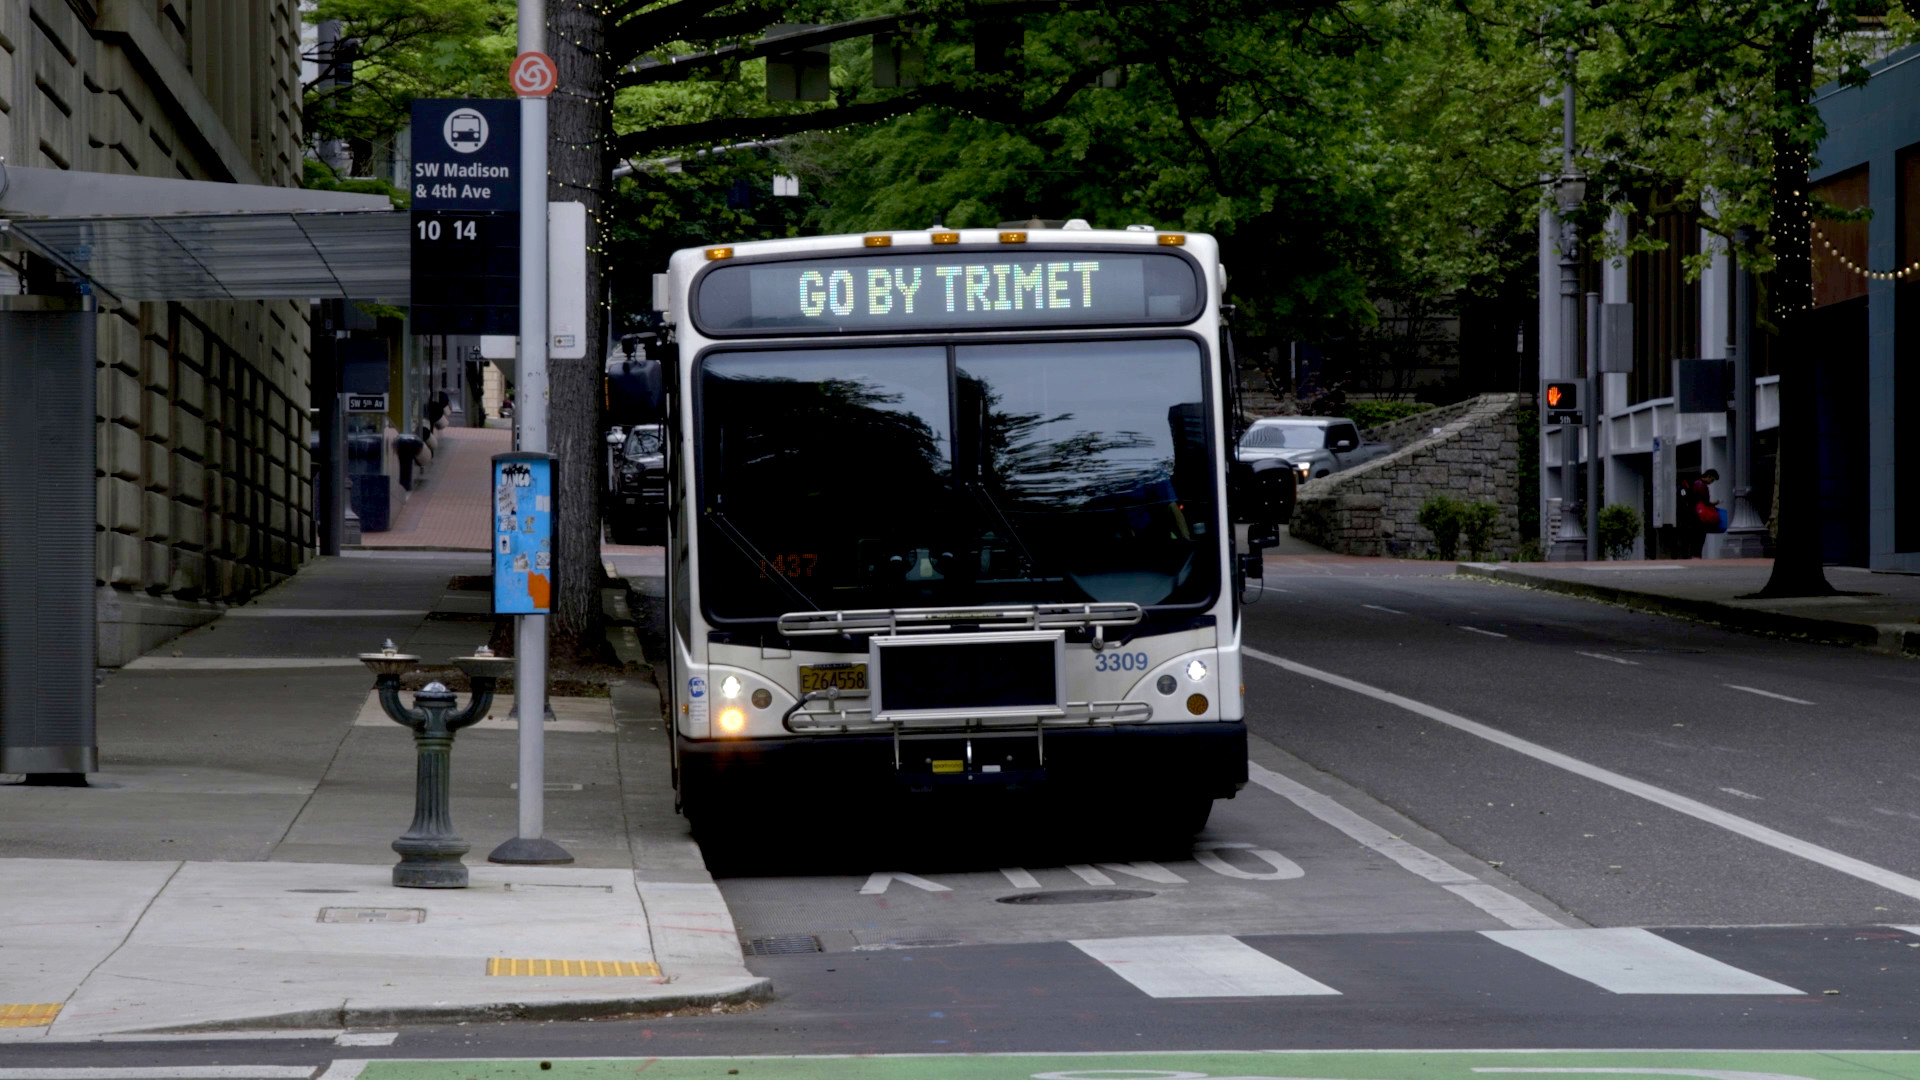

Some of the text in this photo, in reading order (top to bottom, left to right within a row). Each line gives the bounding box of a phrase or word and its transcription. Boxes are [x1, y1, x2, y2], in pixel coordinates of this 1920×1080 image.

[415, 162, 509, 178] SW Madison
[415, 183, 492, 199] & 4th Ave
[417, 220, 477, 240] 10 14
[799, 261, 1099, 317] GO BY TRIMET
[350, 399, 384, 408] SW 5th Av
[1559, 415, 1571, 424] 5th
[1095, 652, 1148, 672] 3309
[802, 671, 865, 690] E264558
